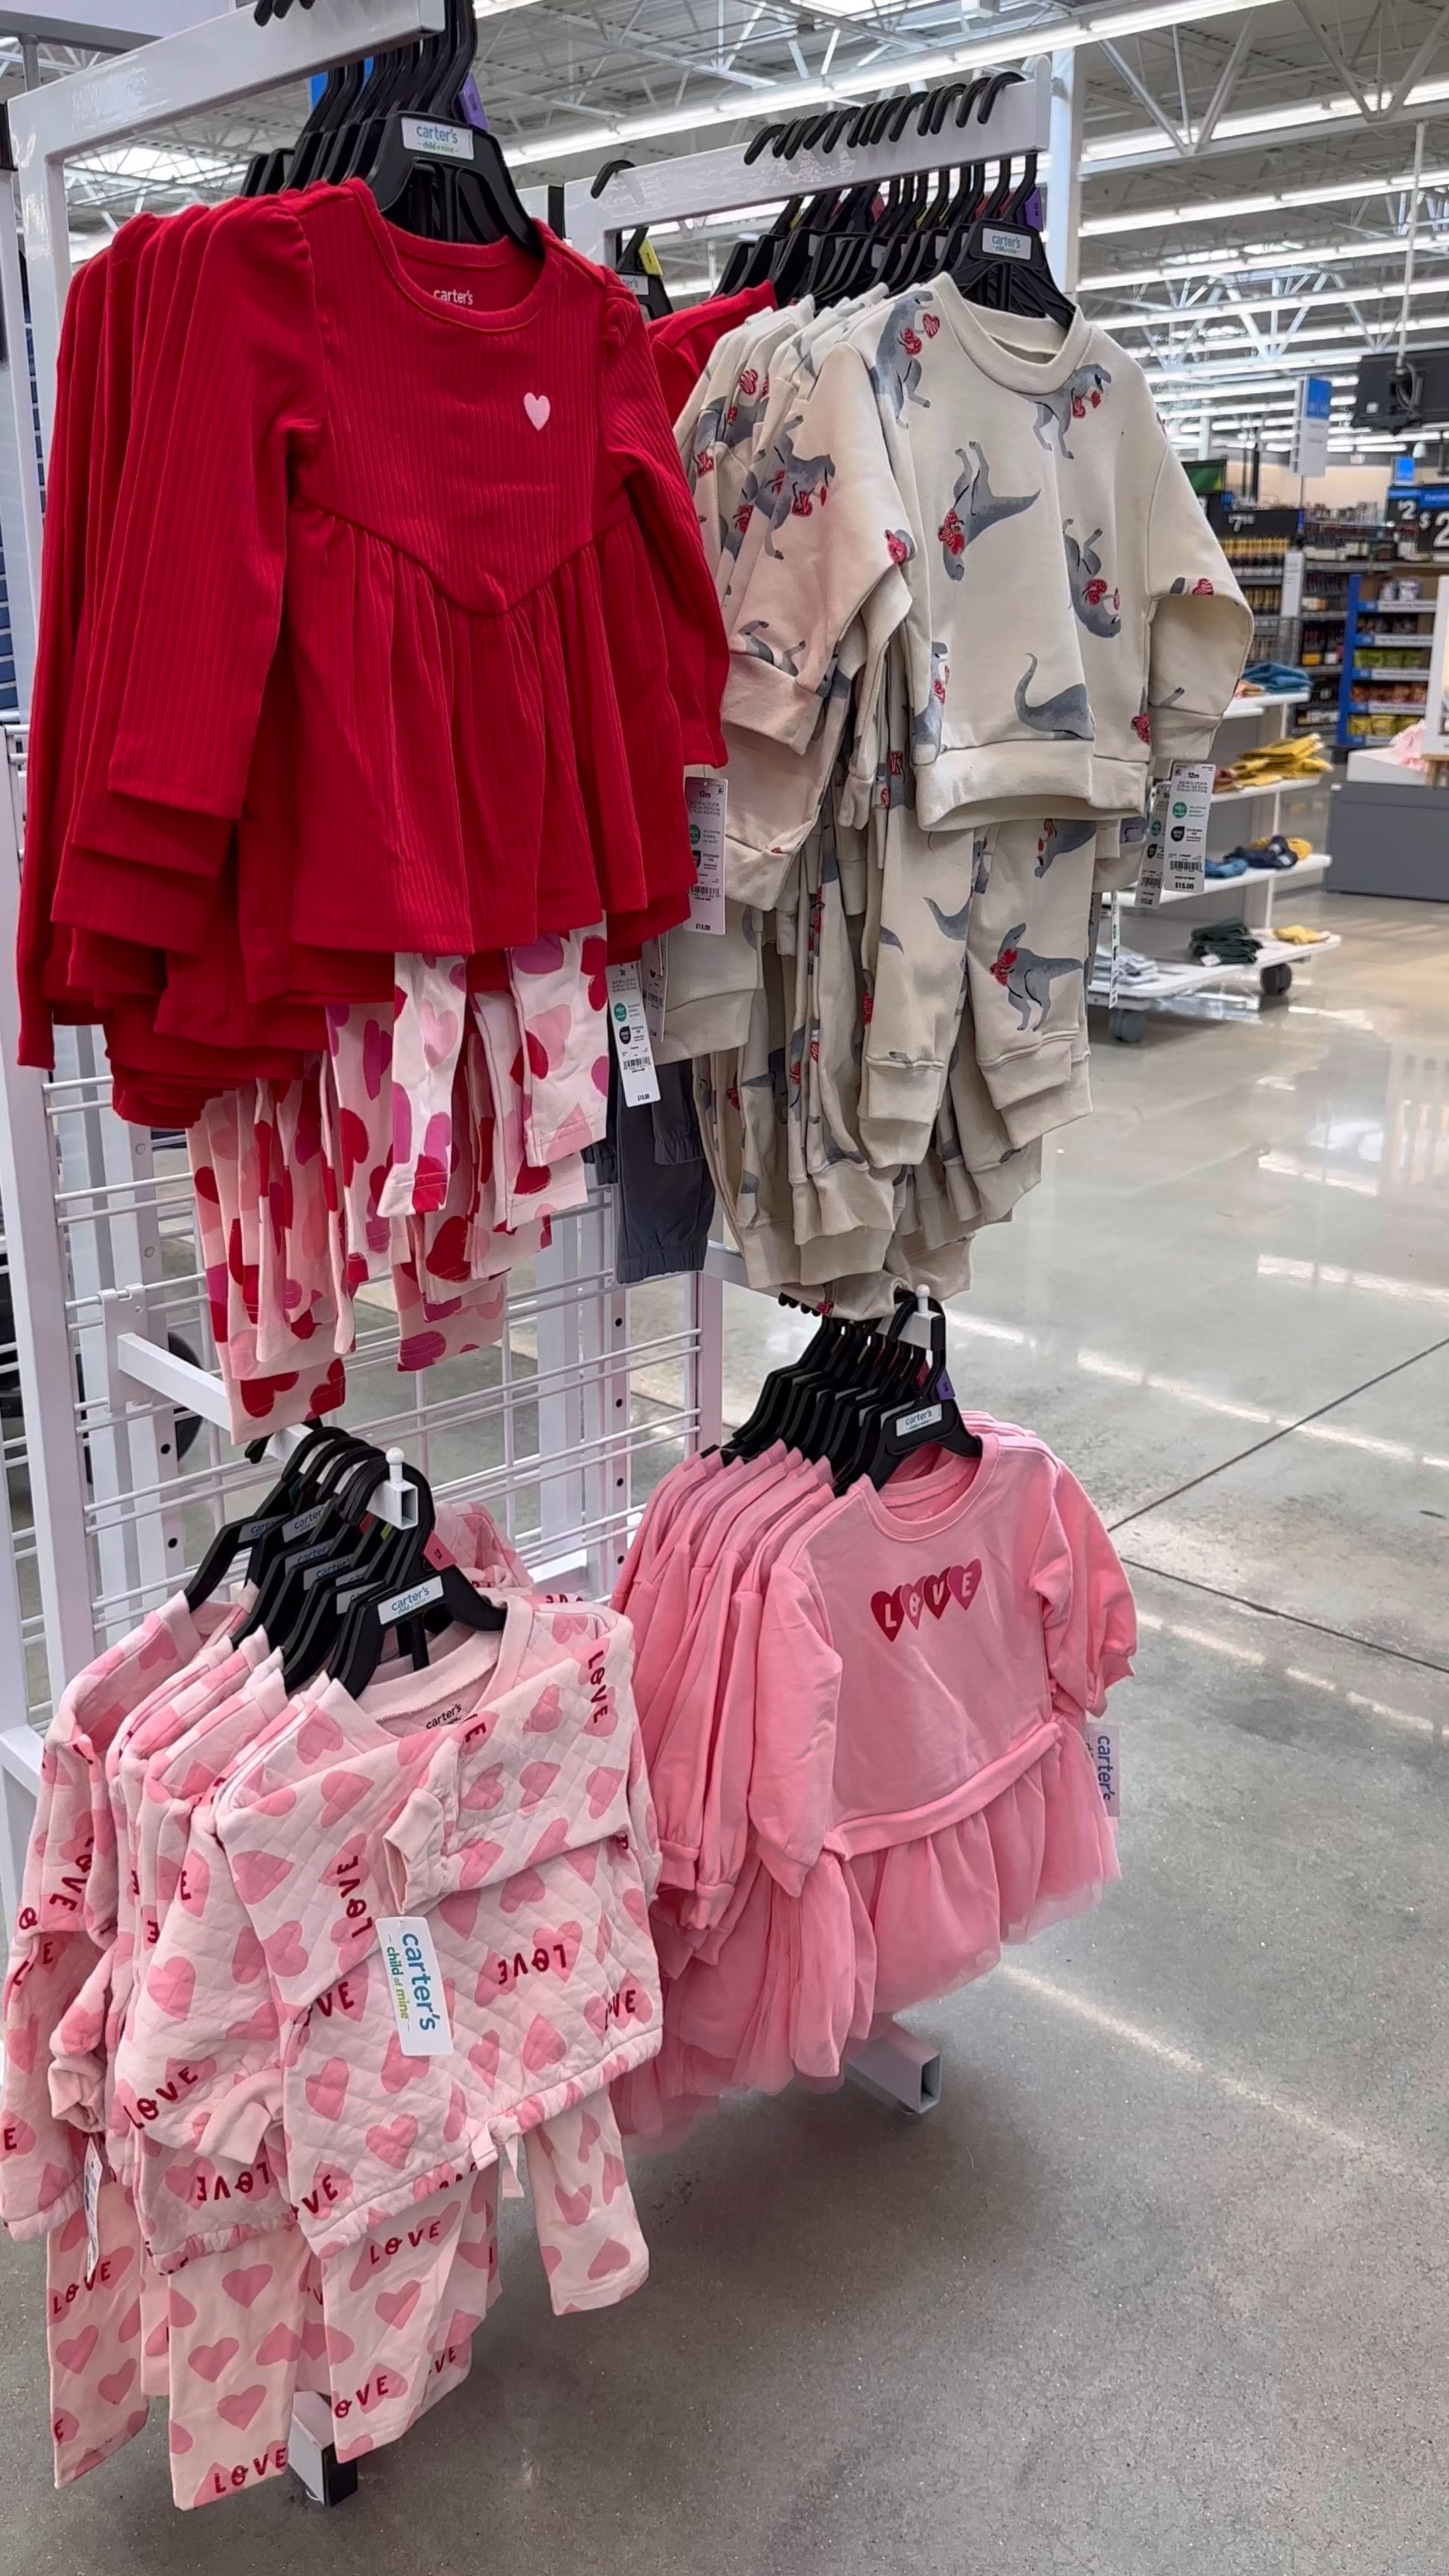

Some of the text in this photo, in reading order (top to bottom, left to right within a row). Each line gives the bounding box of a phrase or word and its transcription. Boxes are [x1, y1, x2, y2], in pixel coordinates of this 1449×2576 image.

[417, 126, 458, 144] carter's
[992, 235, 1021, 249] carter's
[433, 289, 473, 305] carter's
[1175, 881, 1194, 890] $15.00
[905, 1409, 932, 1426] carter's
[294, 1505, 325, 1529] carter'
[392, 1587, 429, 1611] carter's
[885, 1571, 973, 1628] LOVE
[588, 1650, 608, 1723] LOVE
[426, 1703, 462, 1729] carter's
[337, 1855, 373, 1939] LOVE
[386, 1947, 410, 2020] child of mine
[402, 1933, 441, 2031] carter's
[497, 1943, 567, 1985] LOVE
[123, 2067, 198, 2130] LOVE
[197, 2161, 270, 2201] LOVE
[370, 2220, 441, 2265] LOVE
[335, 2375, 389, 2418] OVE
[215, 2447, 286, 2493] LOVE
